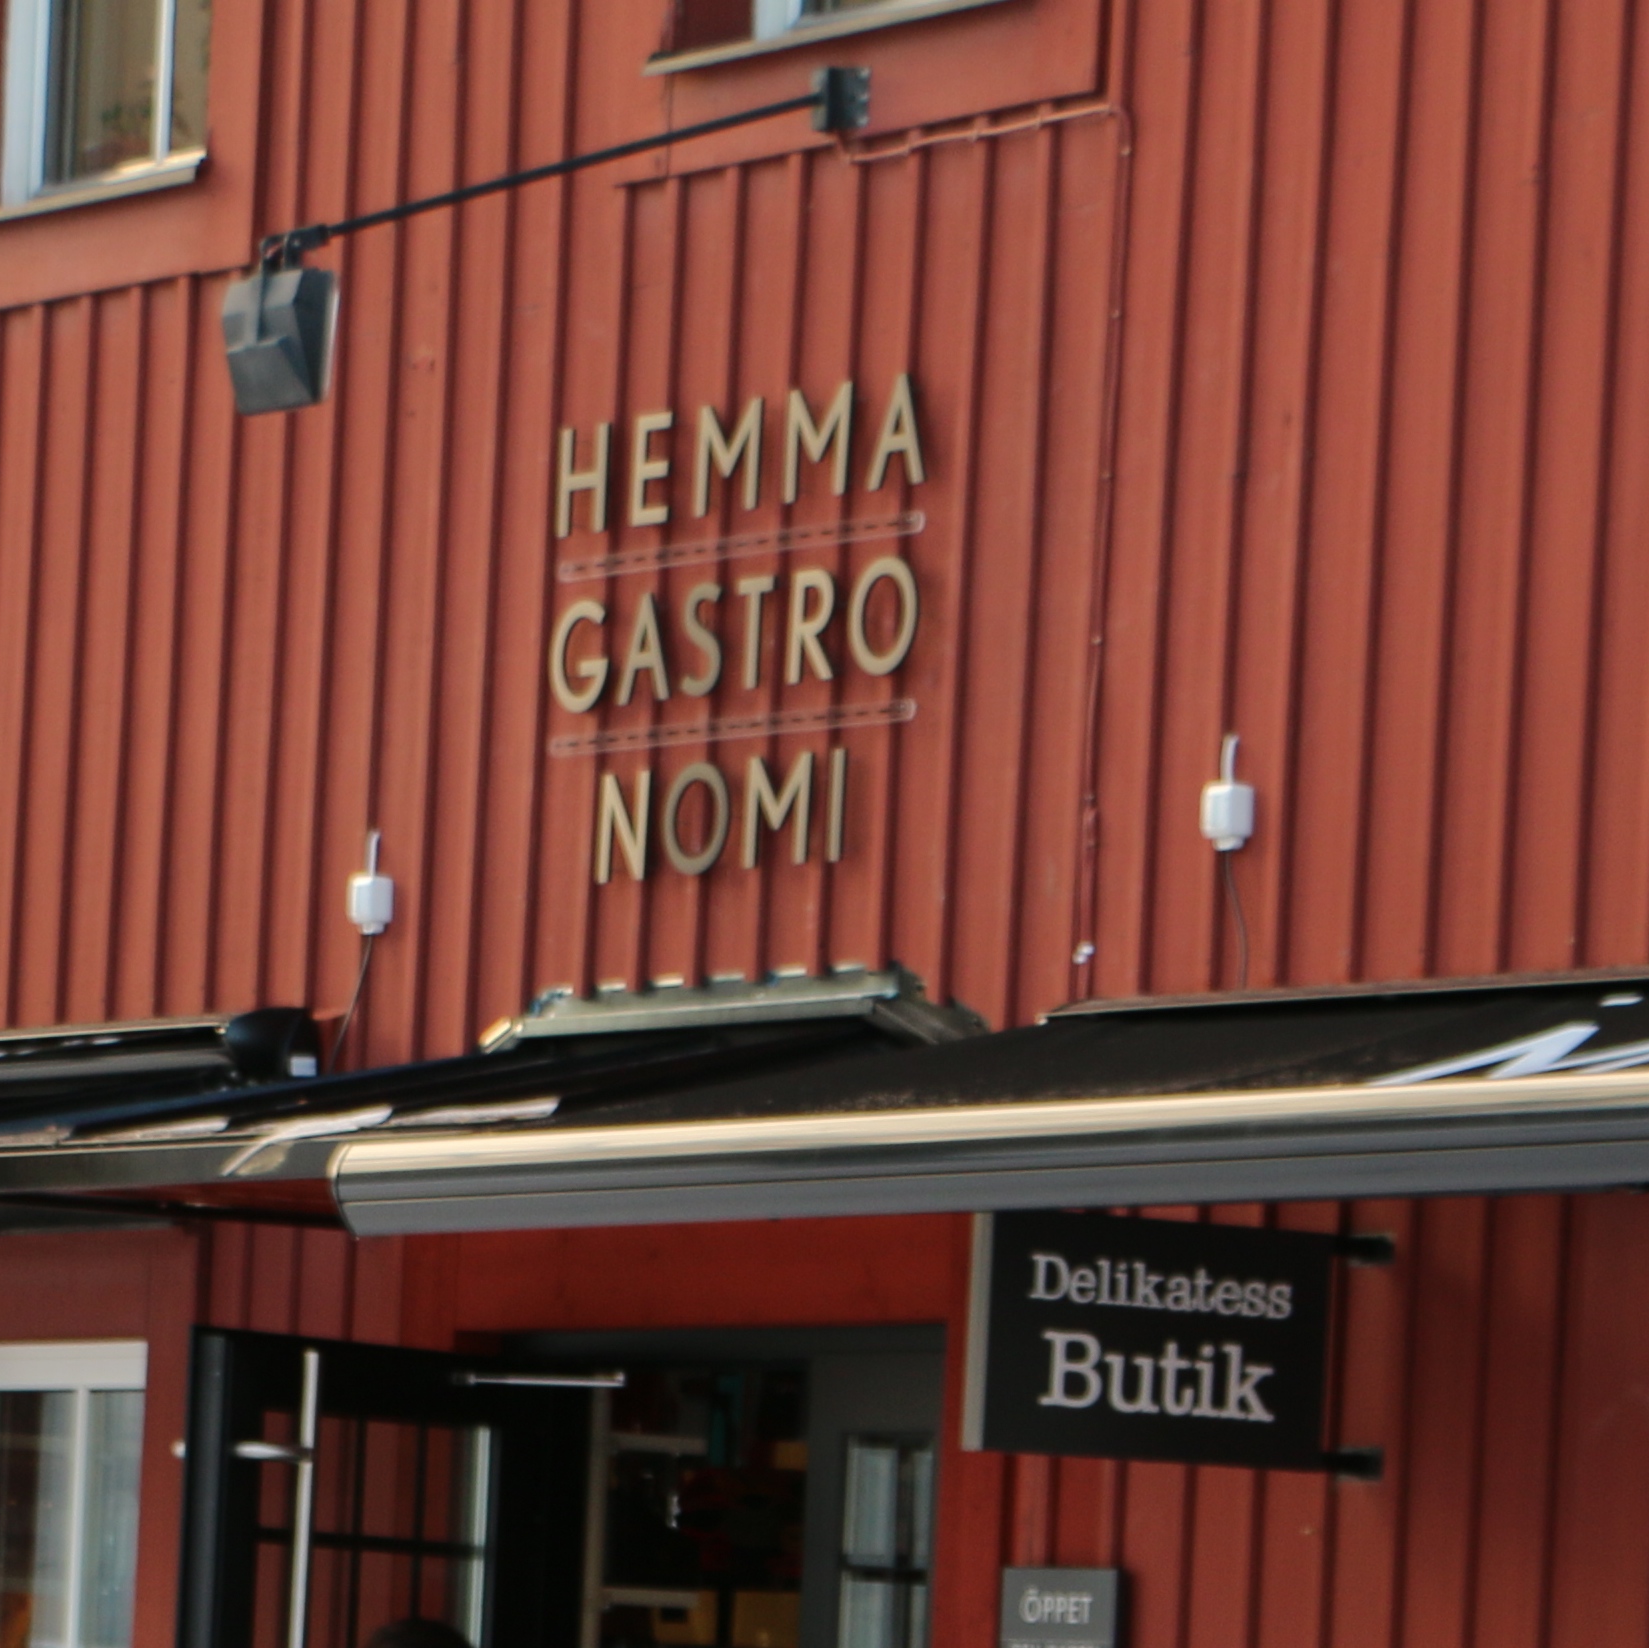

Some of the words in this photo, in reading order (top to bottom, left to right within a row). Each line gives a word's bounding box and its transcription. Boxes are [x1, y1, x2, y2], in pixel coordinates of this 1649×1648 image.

[555, 372, 926, 538] HEMMA
[549, 555, 919, 714] GASTRO
[595, 747, 848, 884] NOMI
[1030, 1252, 1294, 1320] Delikatess
[1038, 1329, 1276, 1424] Butik
[1021, 1586, 1093, 1624] ÖPPET
